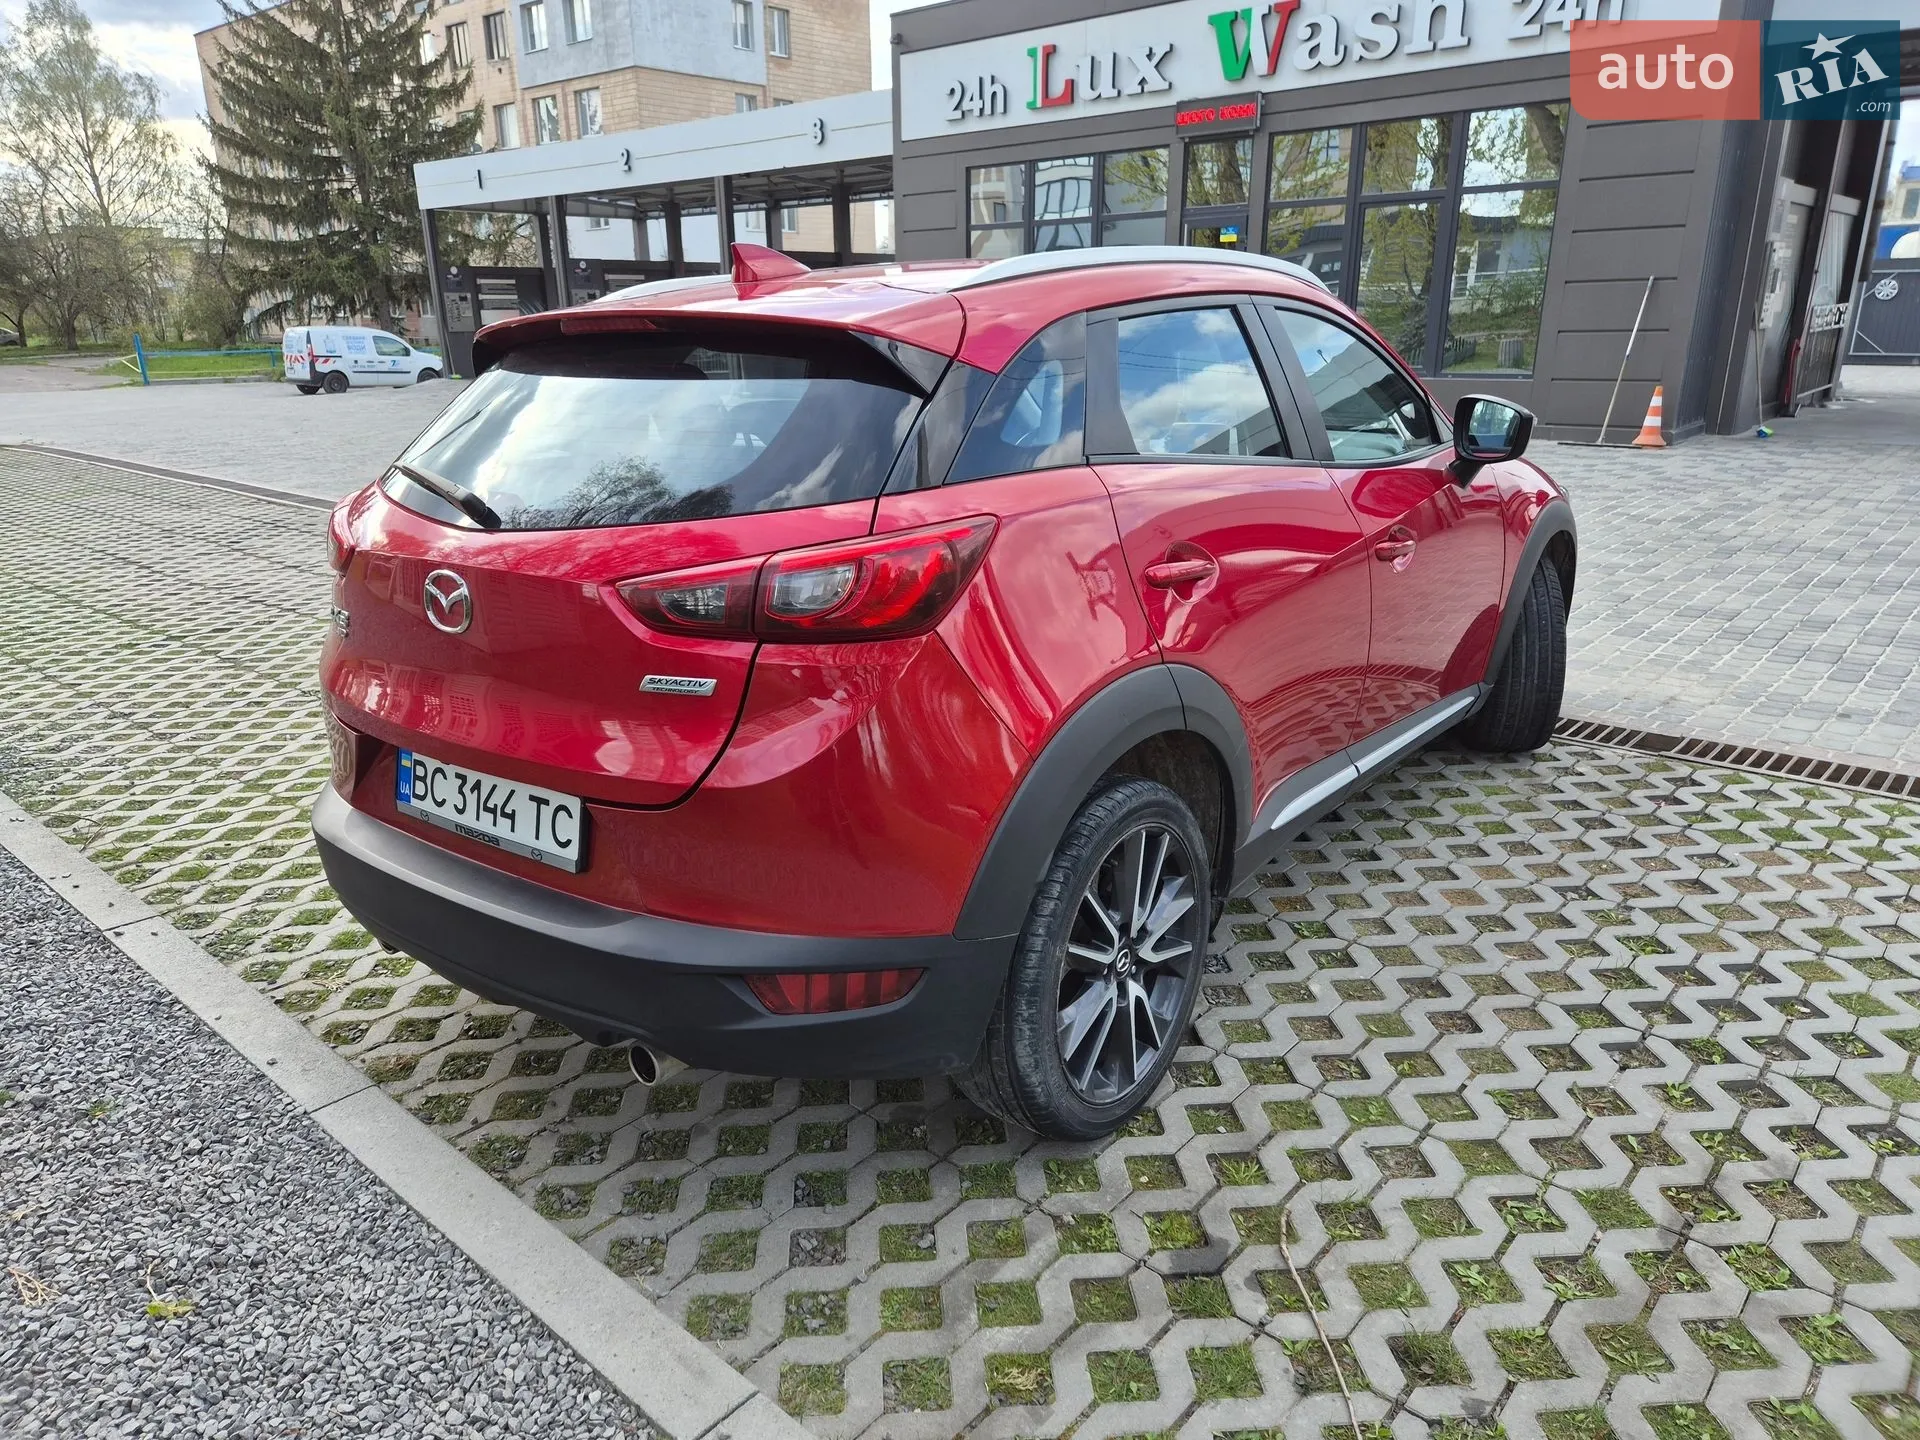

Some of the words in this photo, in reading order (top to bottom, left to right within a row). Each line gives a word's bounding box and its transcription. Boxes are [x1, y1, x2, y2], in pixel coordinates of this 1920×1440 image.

[946, 74, 1007, 121] 24h
[1026, 44, 1173, 109] Lux
[1207, 0, 1470, 81] Wash
[812, 117, 825, 146] 3
[619, 147, 632, 173] 2
[647, 678, 708, 687] SKYACTIV
[400, 780, 411, 795] UA
[412, 758, 448, 808] BC
[453, 771, 517, 834] 3144
[528, 793, 574, 849] TC
